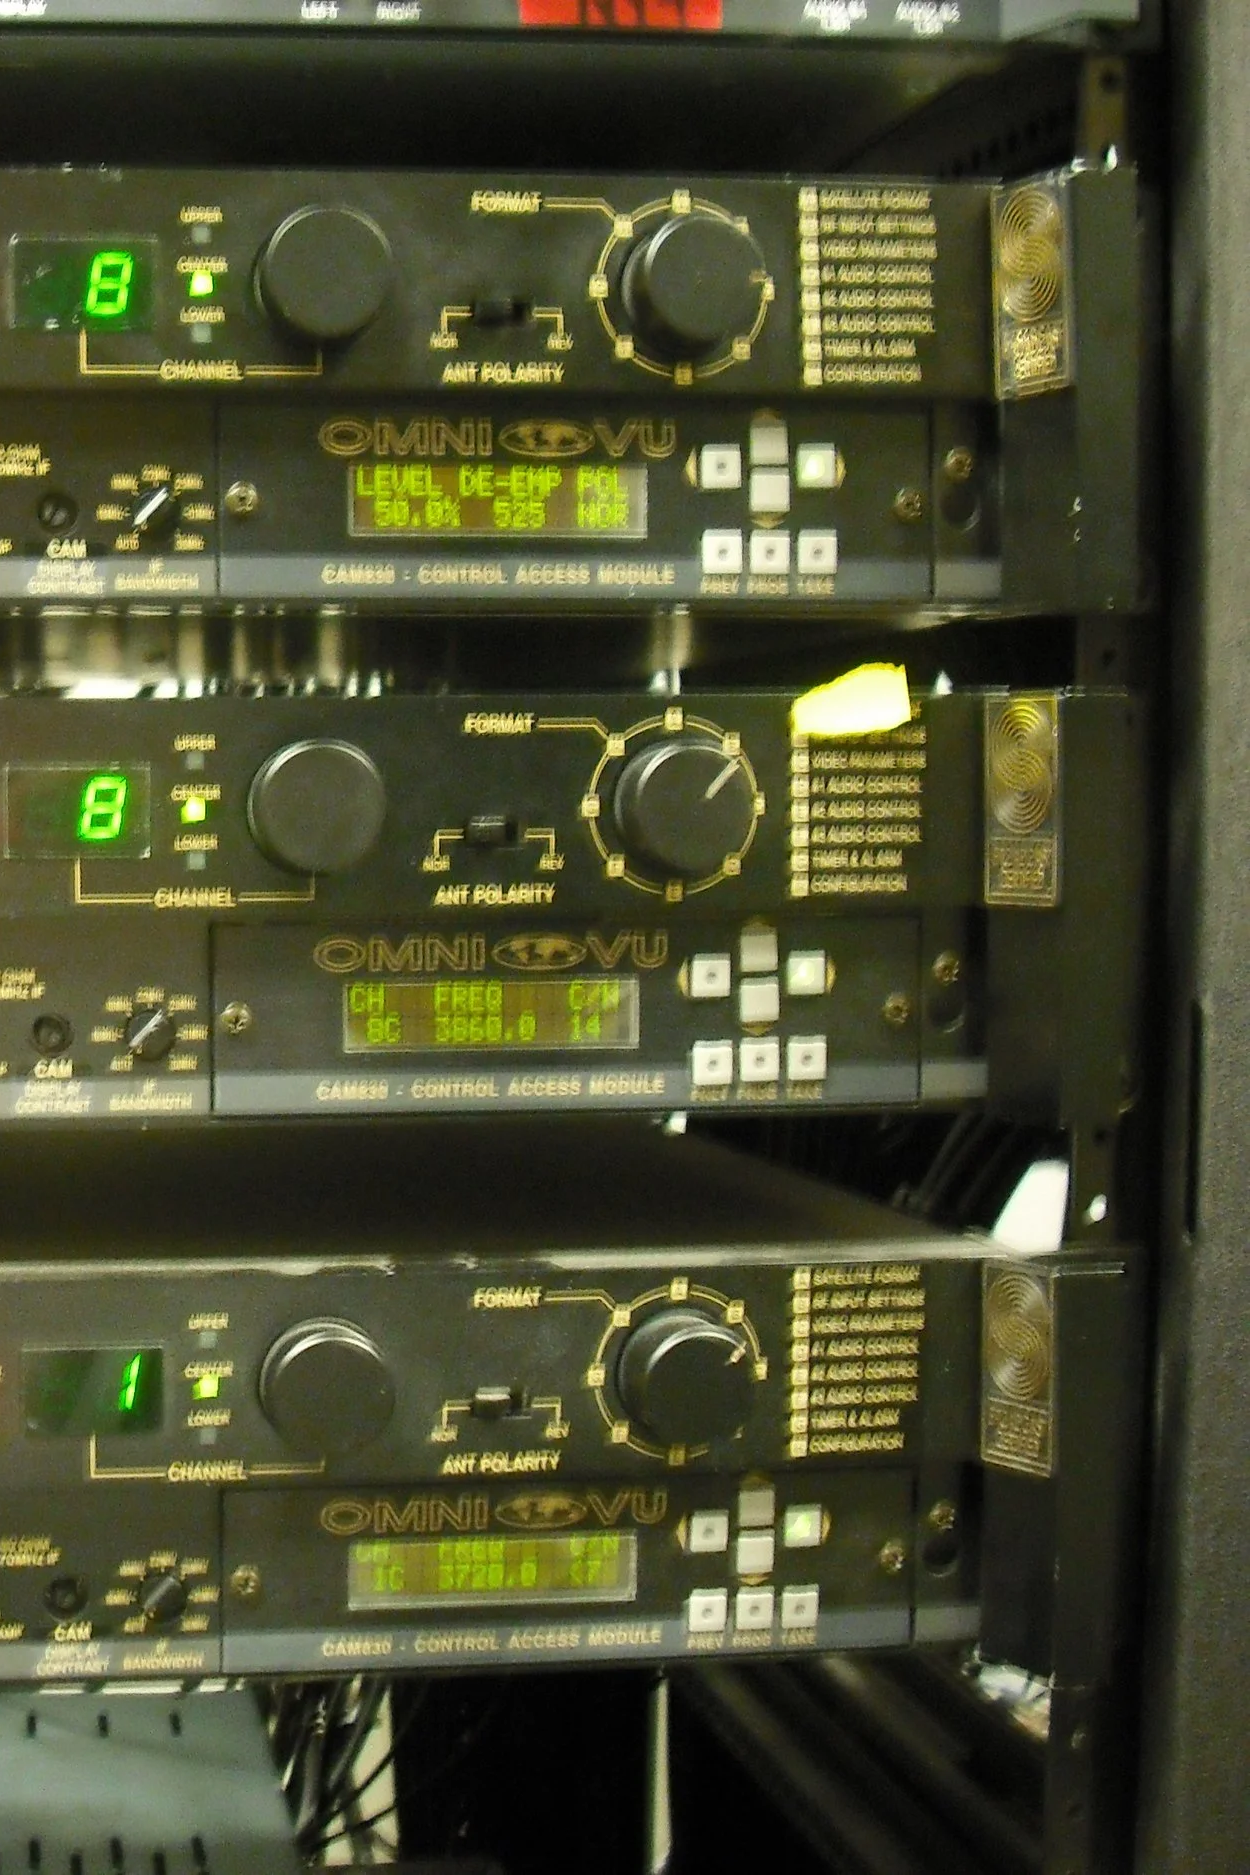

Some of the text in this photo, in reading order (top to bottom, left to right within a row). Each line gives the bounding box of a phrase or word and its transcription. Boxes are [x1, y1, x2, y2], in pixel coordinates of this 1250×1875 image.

[471, 190, 541, 212] FORMAT
[86, 250, 134, 317] 8
[160, 360, 243, 380] CHANNEL
[318, 417, 493, 456] OMNI
[356, 464, 444, 499] LEVEL
[417, 562, 507, 585] CONTROL
[514, 562, 590, 585] ACCESS
[464, 712, 535, 734] FORMAT
[78, 775, 127, 840] 8
[154, 887, 236, 908] CHANNEL
[313, 933, 485, 973] OMNI
[411, 1076, 500, 1099] CONTROL
[507, 1074, 582, 1097] ACCESS
[589, 1072, 666, 1096] MODULE
[474, 1286, 542, 1308] FORMAT
[118, 1353, 141, 1411] 1
[167, 1460, 248, 1482] CHANNEL
[320, 1494, 489, 1535] OMNI
[414, 1630, 499, 1653] CONTROL
[508, 1626, 581, 1650] ACCESS
[587, 1622, 663, 1647] MODULE
